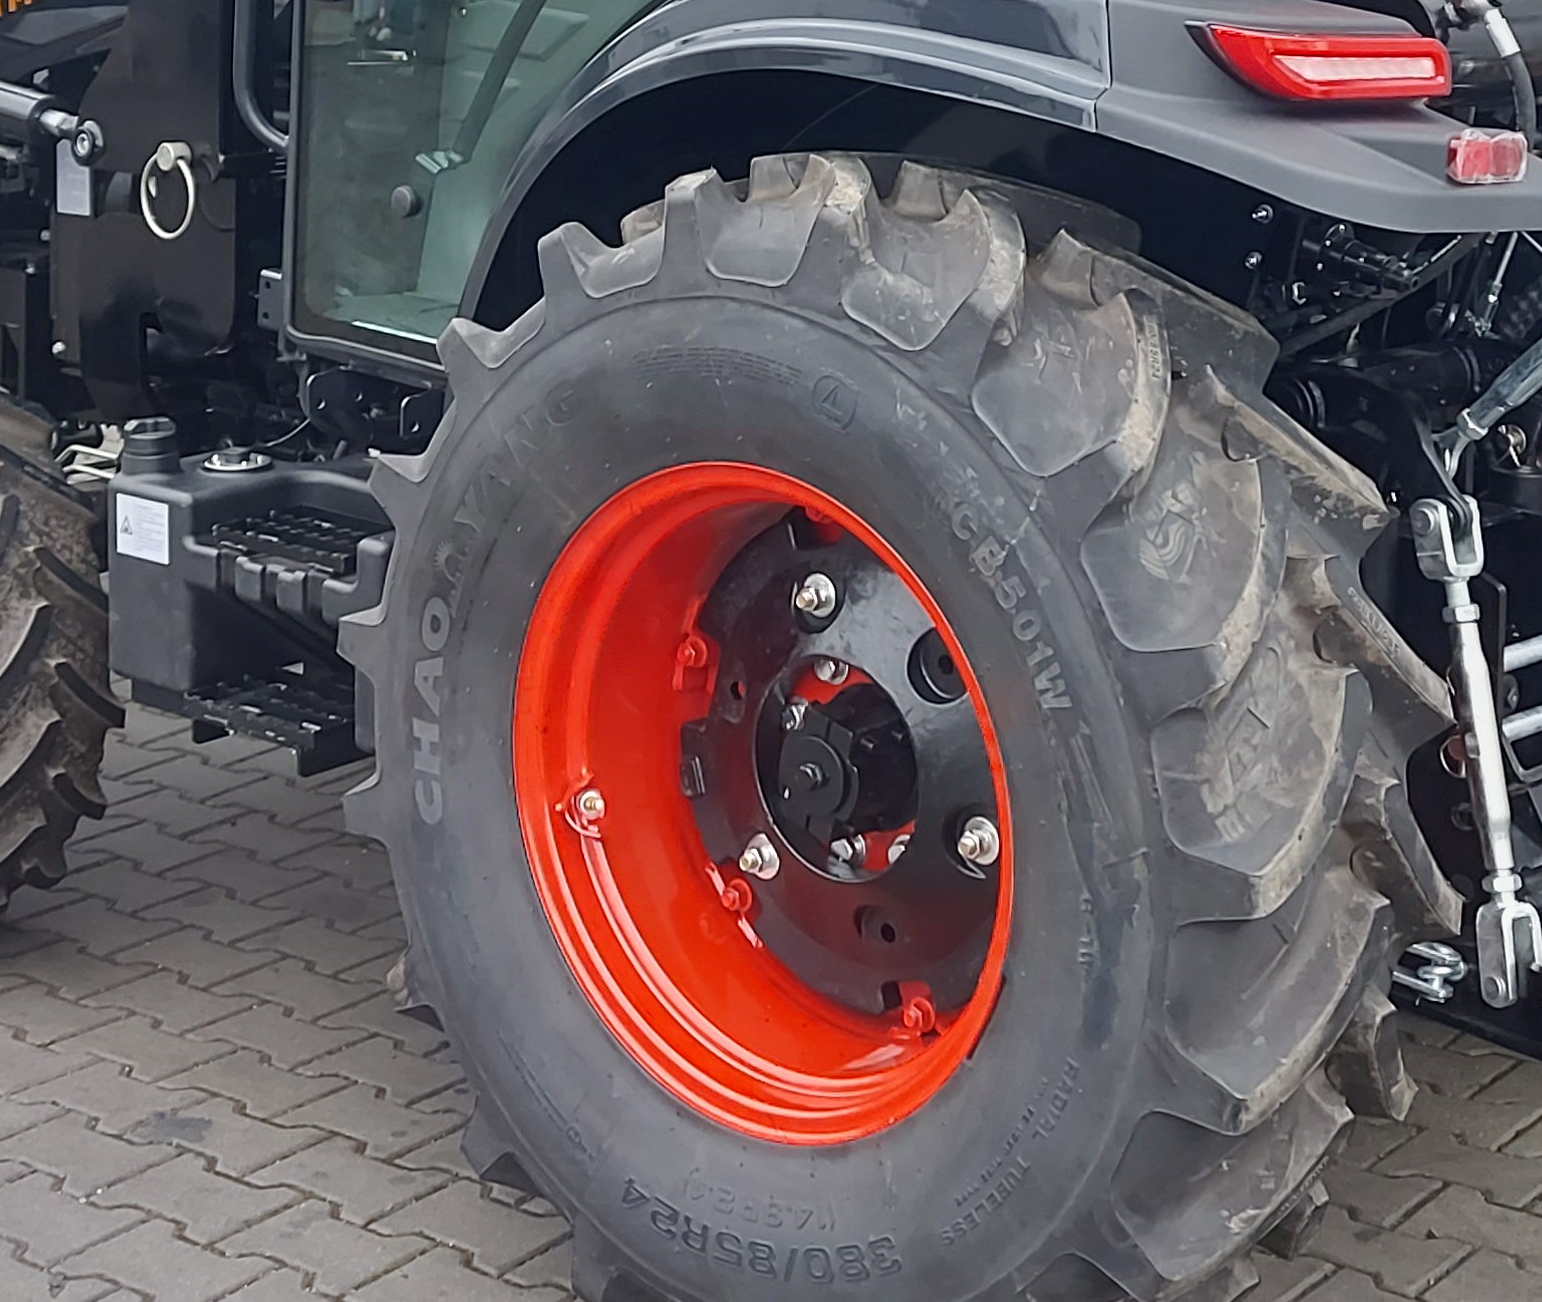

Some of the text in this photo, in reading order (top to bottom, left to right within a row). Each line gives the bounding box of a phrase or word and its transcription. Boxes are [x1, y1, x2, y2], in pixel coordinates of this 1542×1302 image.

[413, 383, 581, 826] CHAO YANG
[1031, 1056, 1081, 1140] RADIAL
[621, 1175, 903, 1285] 380/85R24
[939, 1156, 1032, 1246] TUBELESS
